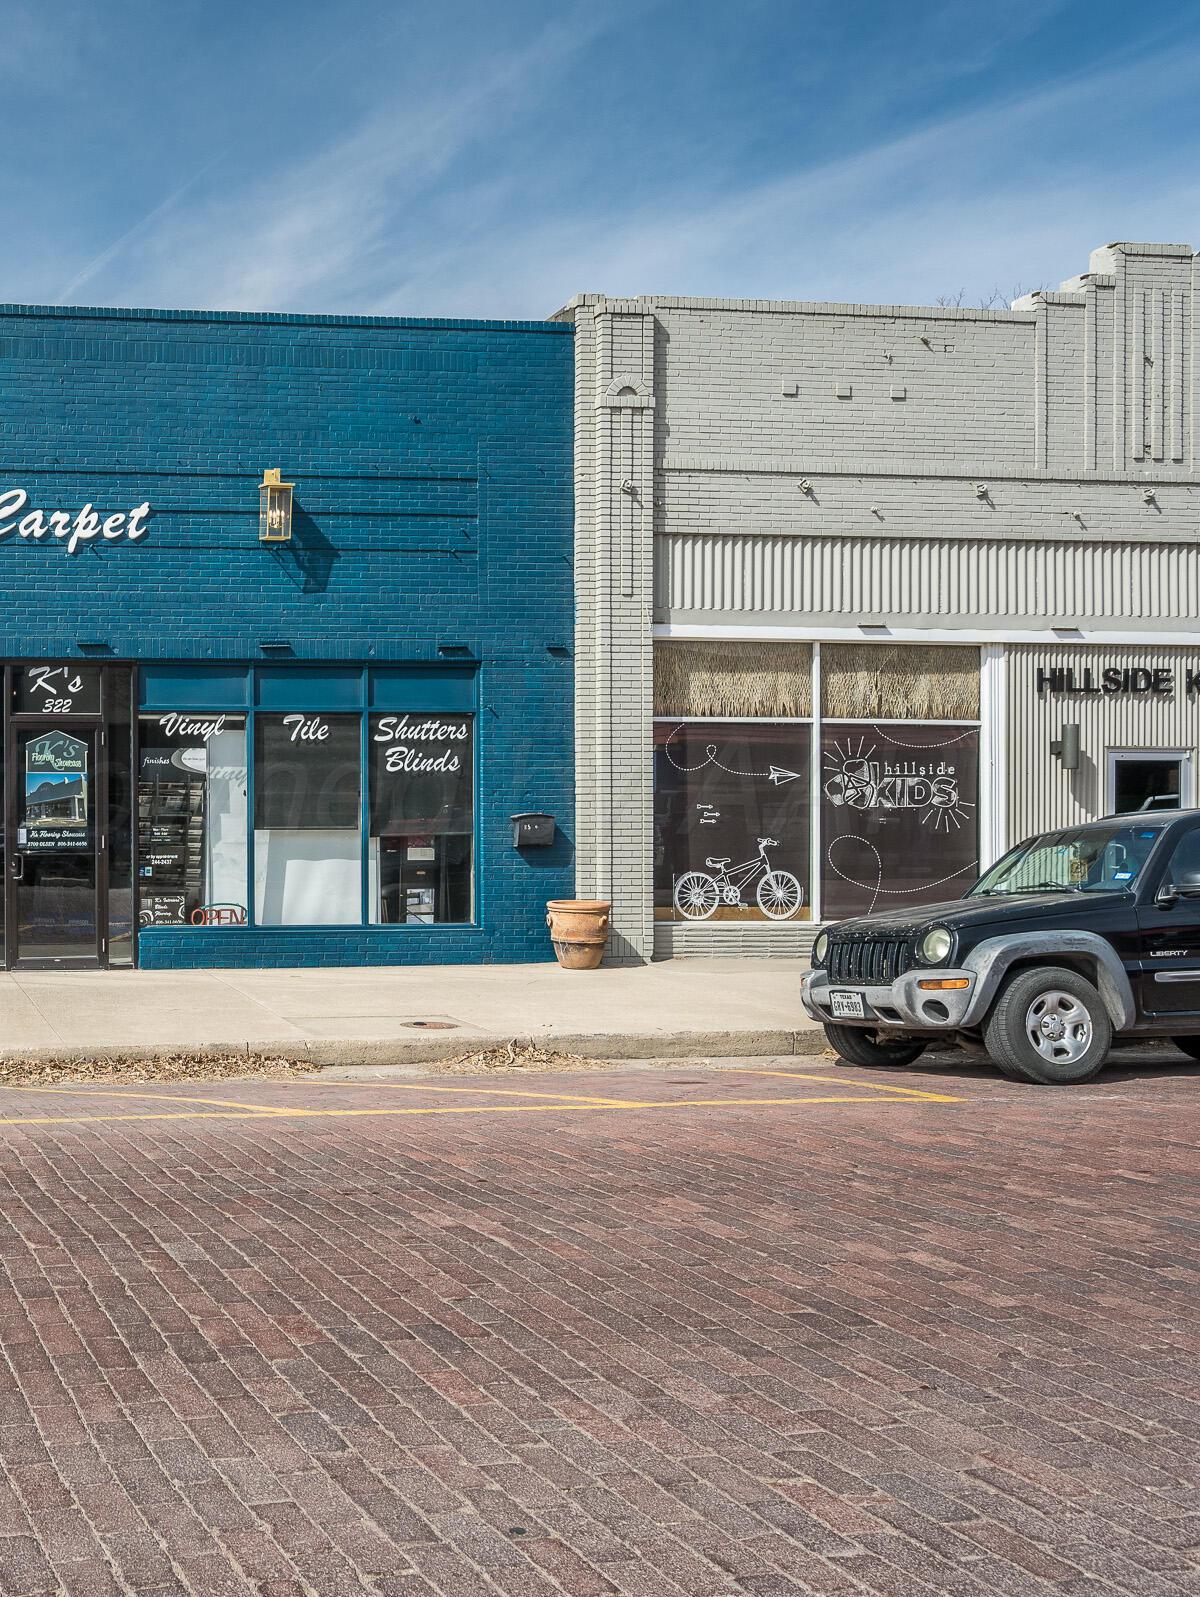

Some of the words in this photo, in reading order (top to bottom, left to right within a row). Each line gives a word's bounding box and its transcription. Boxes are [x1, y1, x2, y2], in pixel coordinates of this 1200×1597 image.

[28, 666, 84, 695] K's
[1036, 667, 1173, 693] HILLSIDE
[42, 698, 72, 713] 322
[159, 712, 226, 742] Vinyl
[282, 714, 330, 742] Tile
[373, 714, 469, 742] Shutters
[142, 756, 170, 768] finishes
[385, 746, 461, 772] Blinds
[884, 760, 956, 776] hillside
[868, 761, 957, 808] KIDS
[190, 907, 246, 926] OPEN
[1149, 949, 1189, 957] LIBERTY
